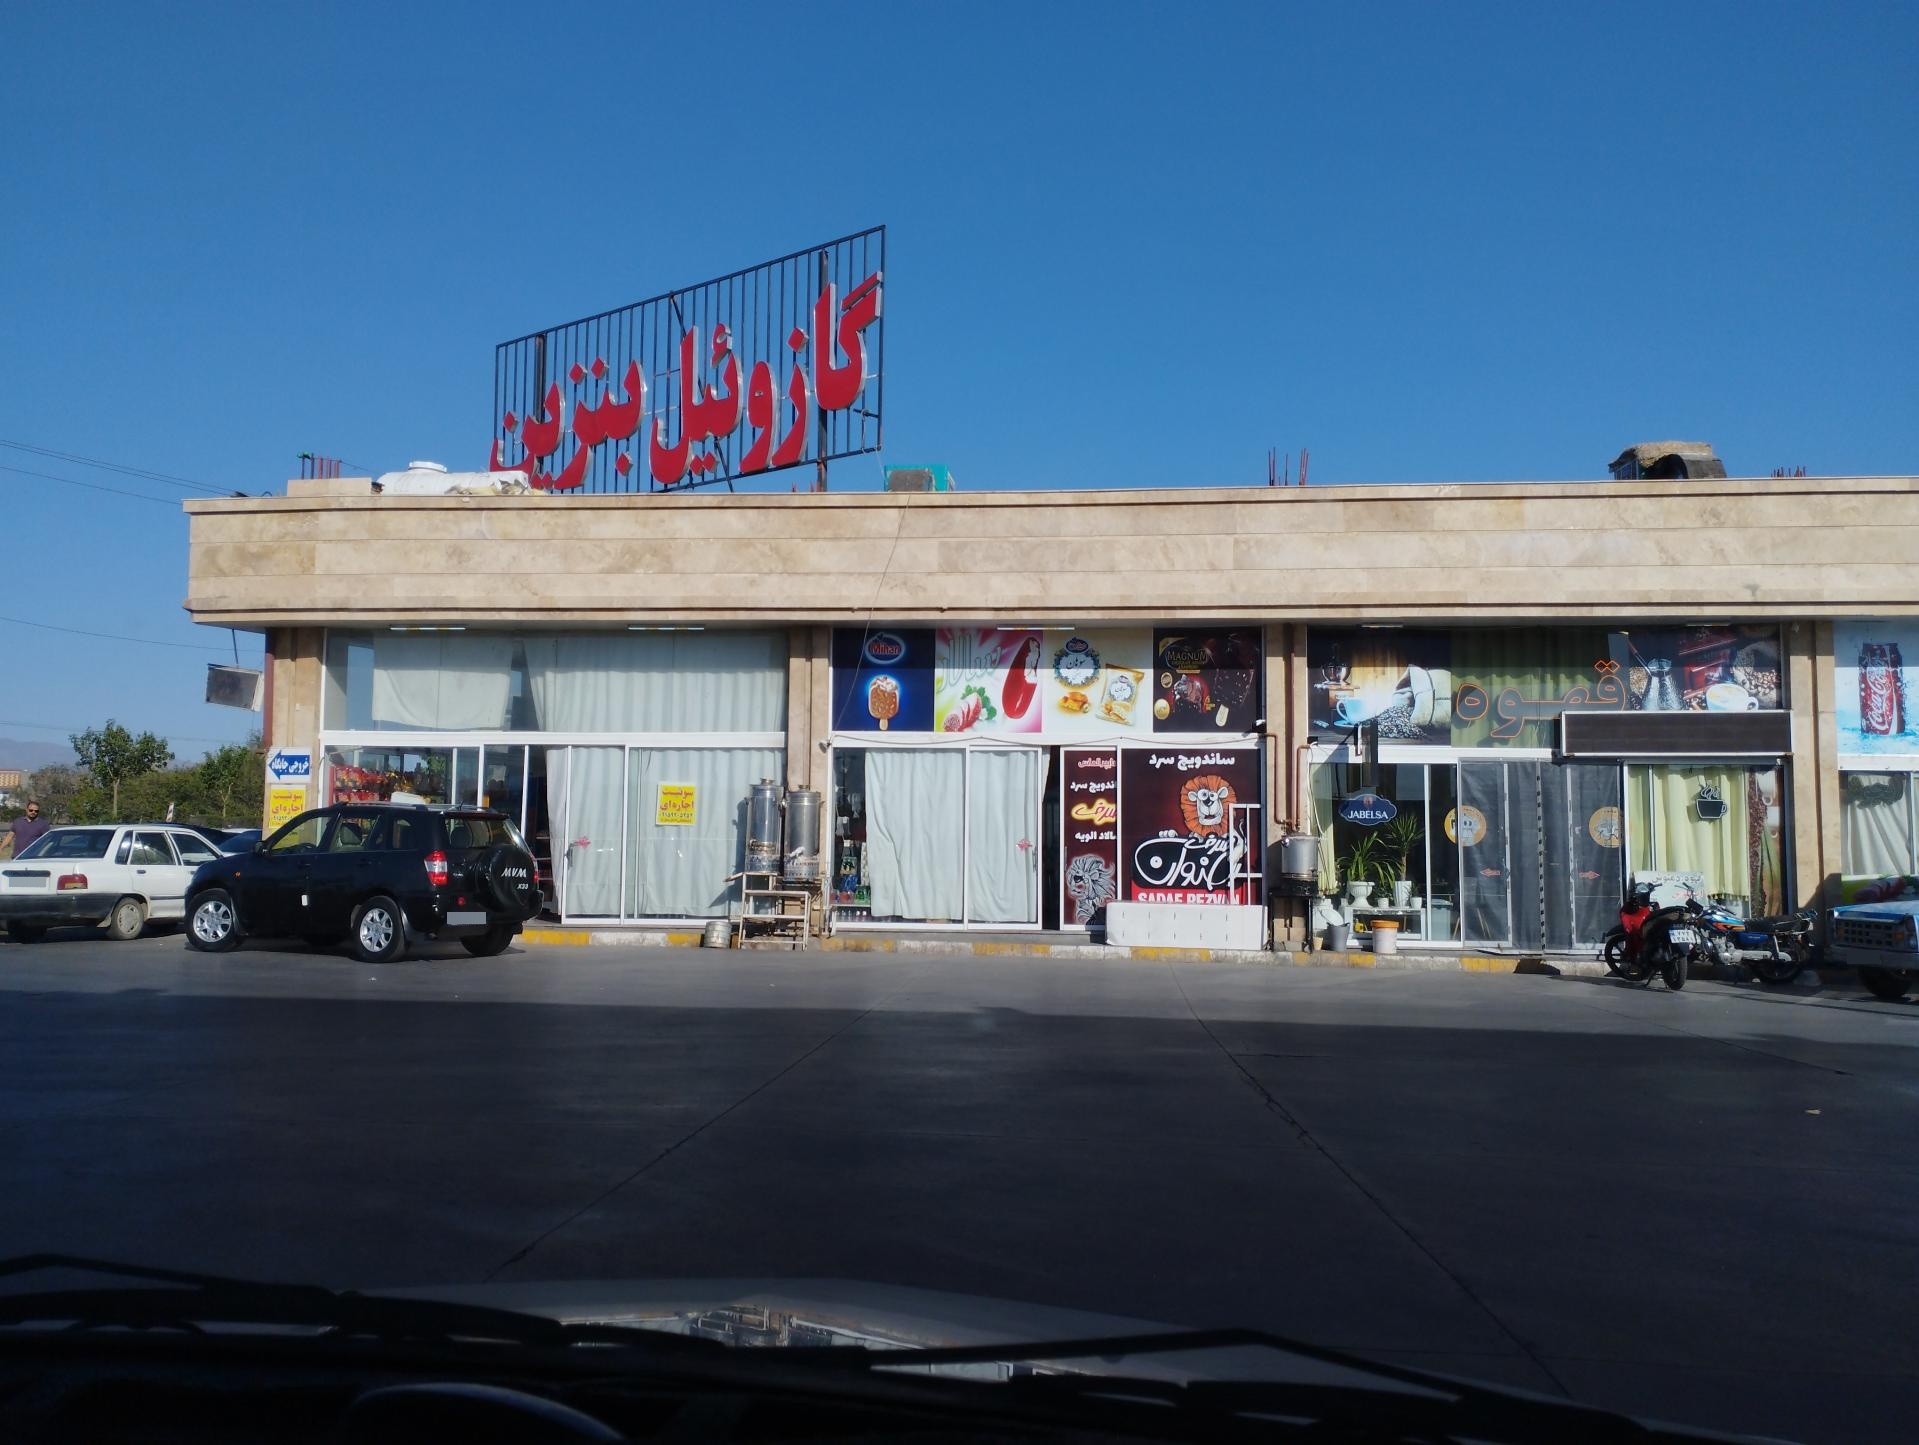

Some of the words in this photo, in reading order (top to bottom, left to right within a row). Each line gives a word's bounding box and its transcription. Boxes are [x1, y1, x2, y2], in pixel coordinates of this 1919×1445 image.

[649, 270, 883, 484] گازوئیل
[489, 359, 646, 490] بنزین
[1167, 649, 1208, 661] MAGNUM
[271, 757, 289, 773] جایگاه
[288, 757, 309, 773] خروجی
[1149, 753, 1176, 769] سرد
[1177, 752, 1236, 771] ساندویچ
[1070, 780, 1088, 792] سرد
[1088, 781, 1117, 793] اندویچ
[1347, 810, 1389, 819] JABELSA
[1074, 830, 1098, 843] الویه
[501, 867, 527, 878] MVM
